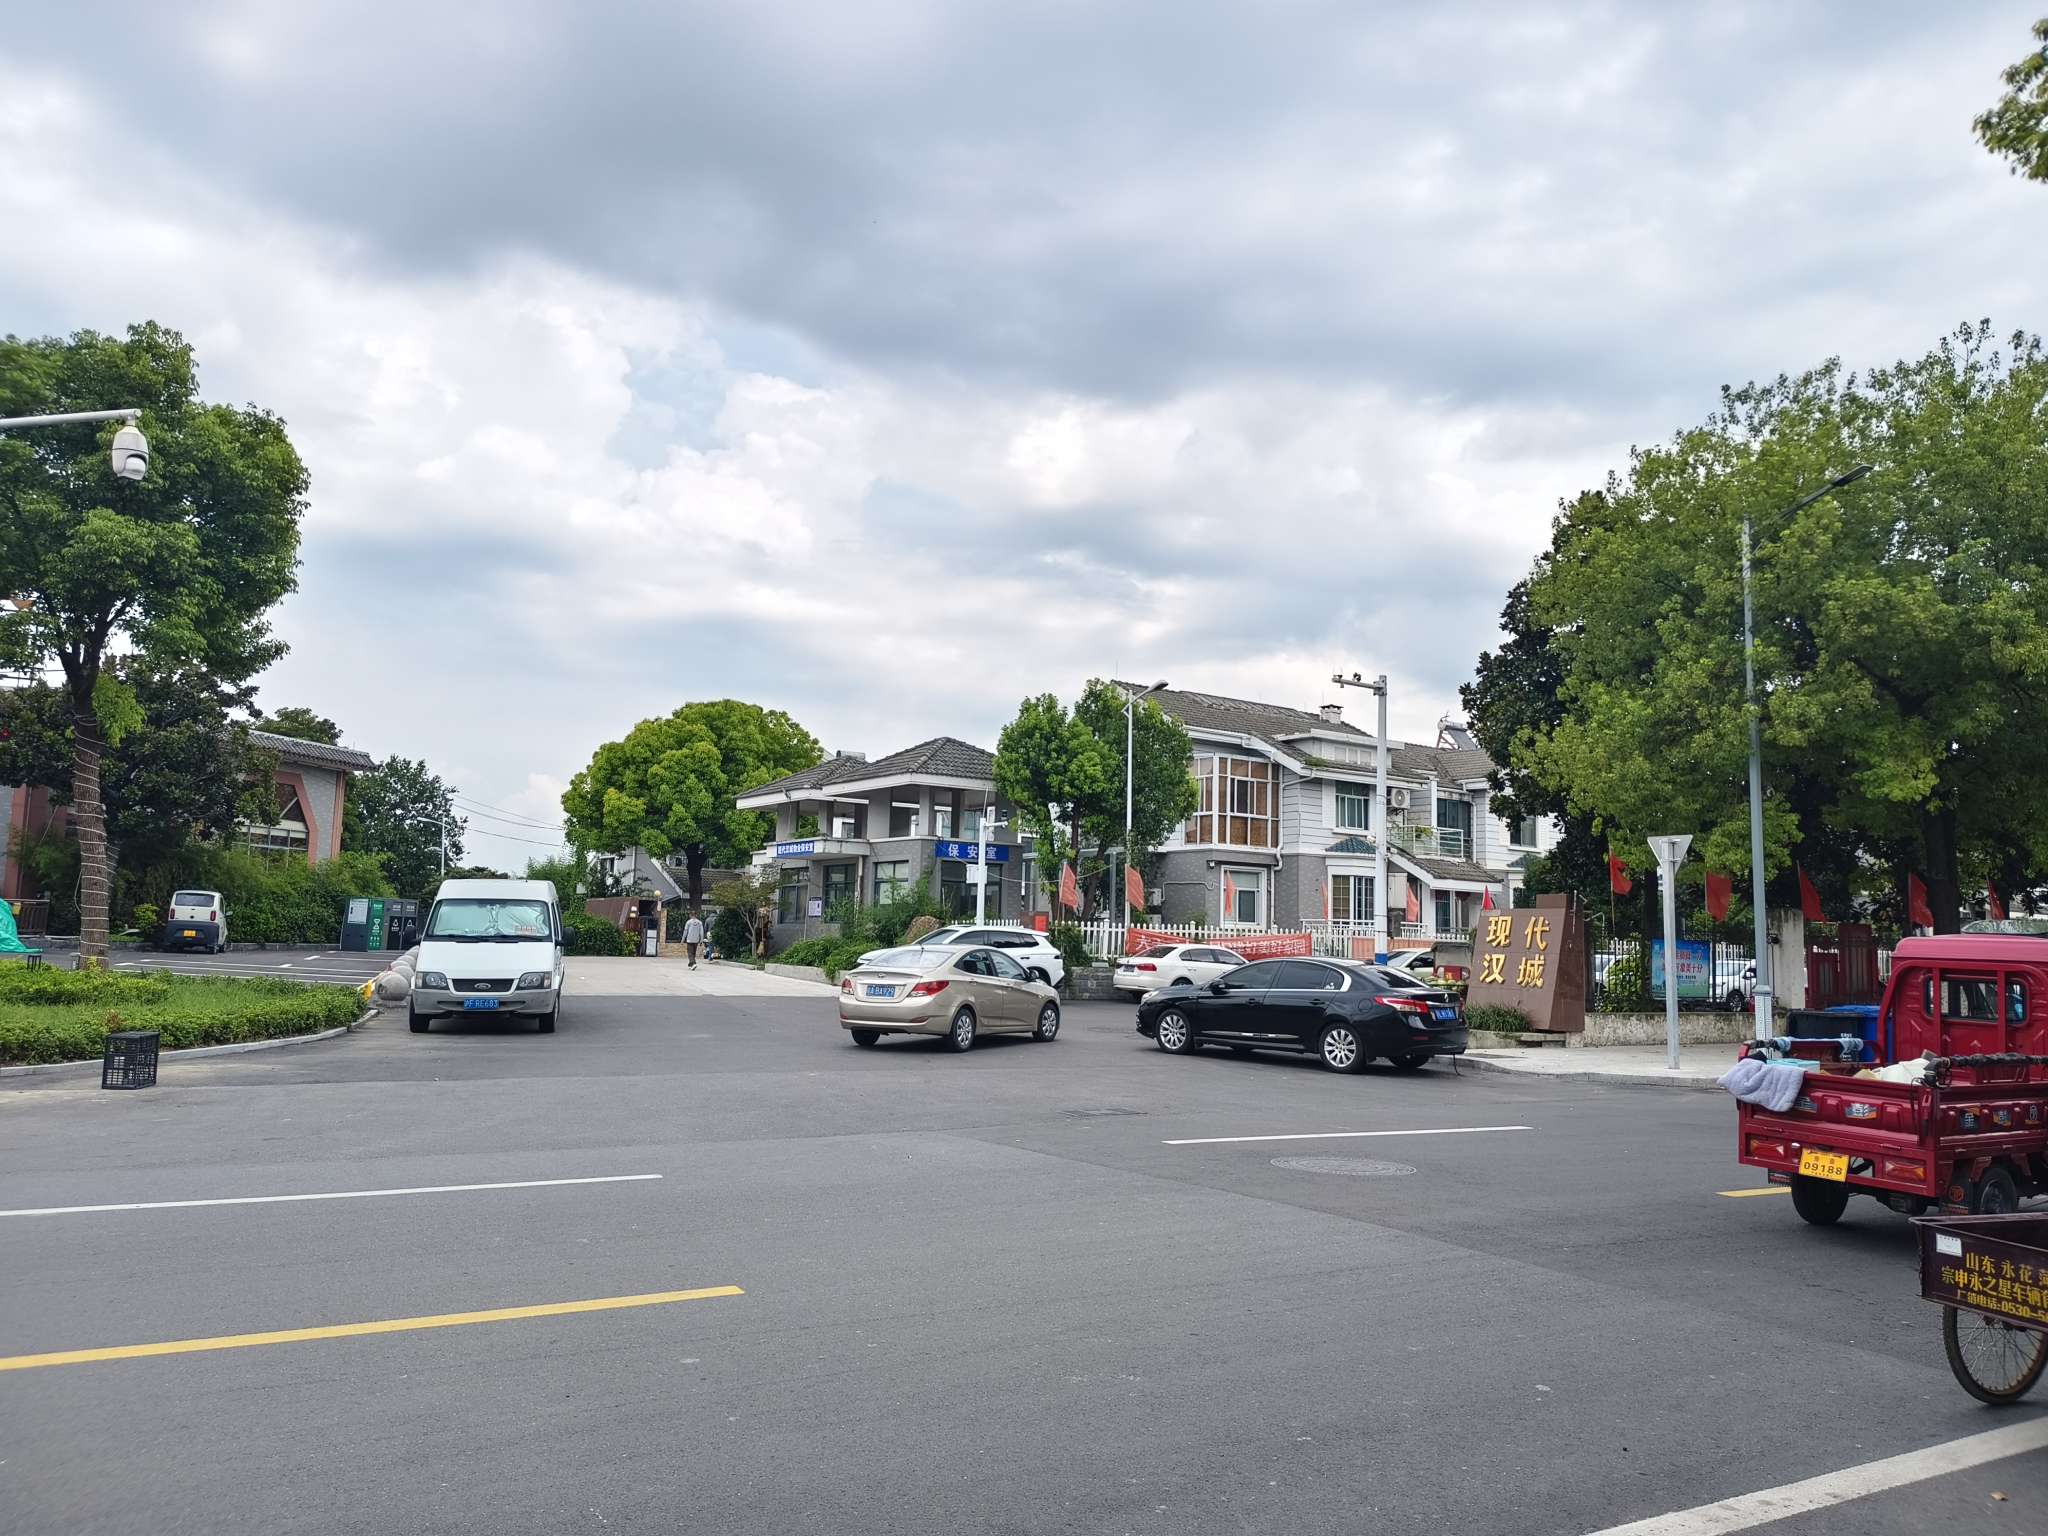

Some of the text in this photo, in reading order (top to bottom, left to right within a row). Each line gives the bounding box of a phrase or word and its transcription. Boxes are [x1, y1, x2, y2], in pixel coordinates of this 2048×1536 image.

[948, 843, 997, 859] 保安室
[1486, 916, 1550, 950] 现代
[1480, 954, 1545, 988] 汉城
[1803, 1161, 1843, 1175] 09188
